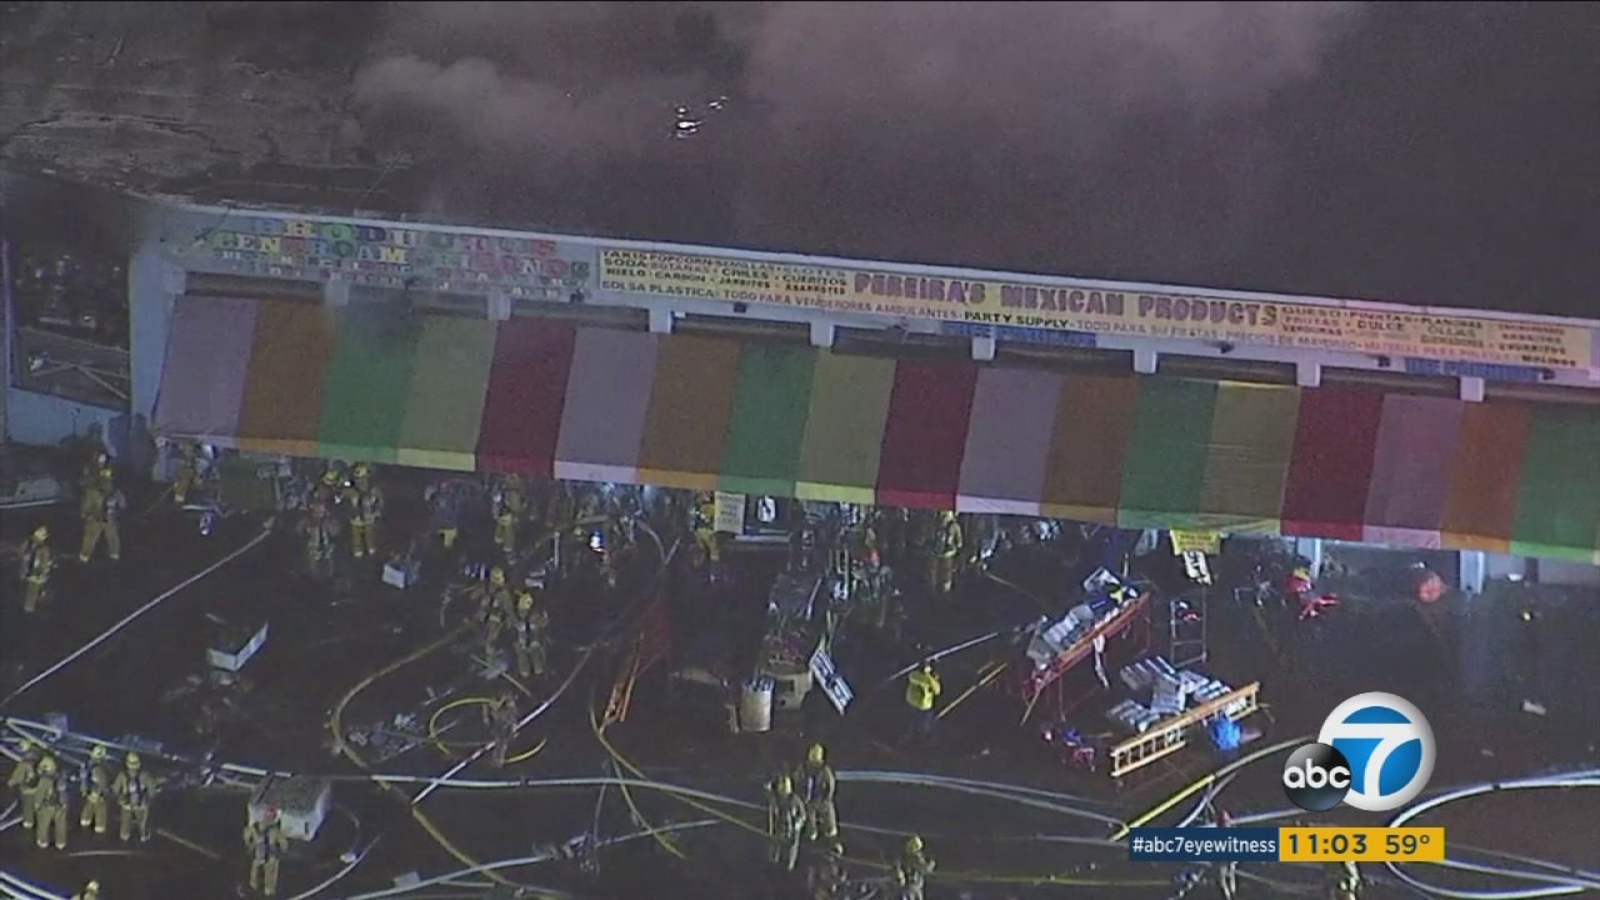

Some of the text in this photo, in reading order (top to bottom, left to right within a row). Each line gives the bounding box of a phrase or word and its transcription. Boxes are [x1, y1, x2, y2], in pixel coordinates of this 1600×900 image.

[604, 258, 647, 268] SODA
[722, 268, 769, 280] CHILES
[606, 268, 646, 277] HIELO
[654, 271, 706, 282] CARBON
[854, 272, 1277, 326] PEREIRA'S MEXICAN PRODUCTS
[649, 284, 715, 297] PLASTICA
[724, 289, 757, 300] TODO
[759, 293, 791, 304] PARA
[964, 310, 1012, 323] PARTY
[1016, 315, 1069, 328] SUPPLY
[1079, 320, 1110, 331] TODO
[1114, 323, 1146, 334] PARA
[1282, 306, 1341, 318] QUESO
[1284, 315, 1340, 327] FRUTAS
[1357, 319, 1405, 332] DULCE
